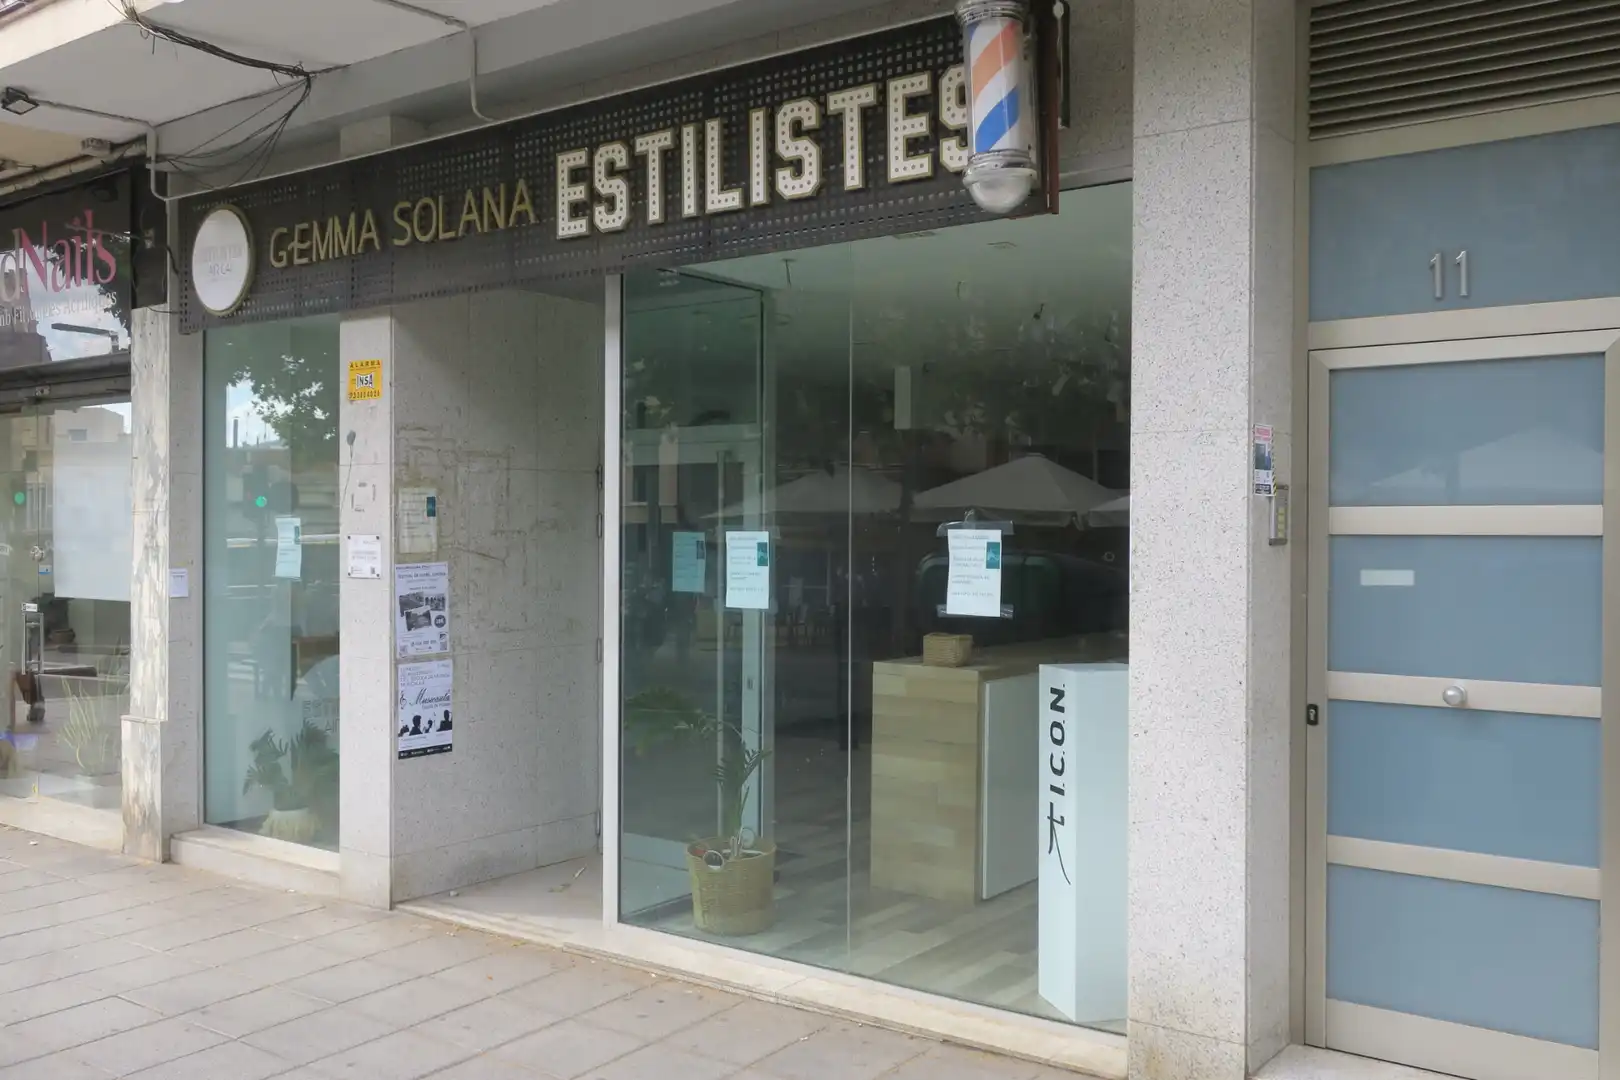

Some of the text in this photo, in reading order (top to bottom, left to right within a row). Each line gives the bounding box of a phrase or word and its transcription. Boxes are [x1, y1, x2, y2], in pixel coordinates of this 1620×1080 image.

[556, 63, 968, 240] ESTILISTES
[269, 178, 537, 269] GEMMA SOLANA
[1430, 250, 1468, 299] 11
[350, 360, 381, 368] ALARMA
[356, 374, 373, 388] INSA
